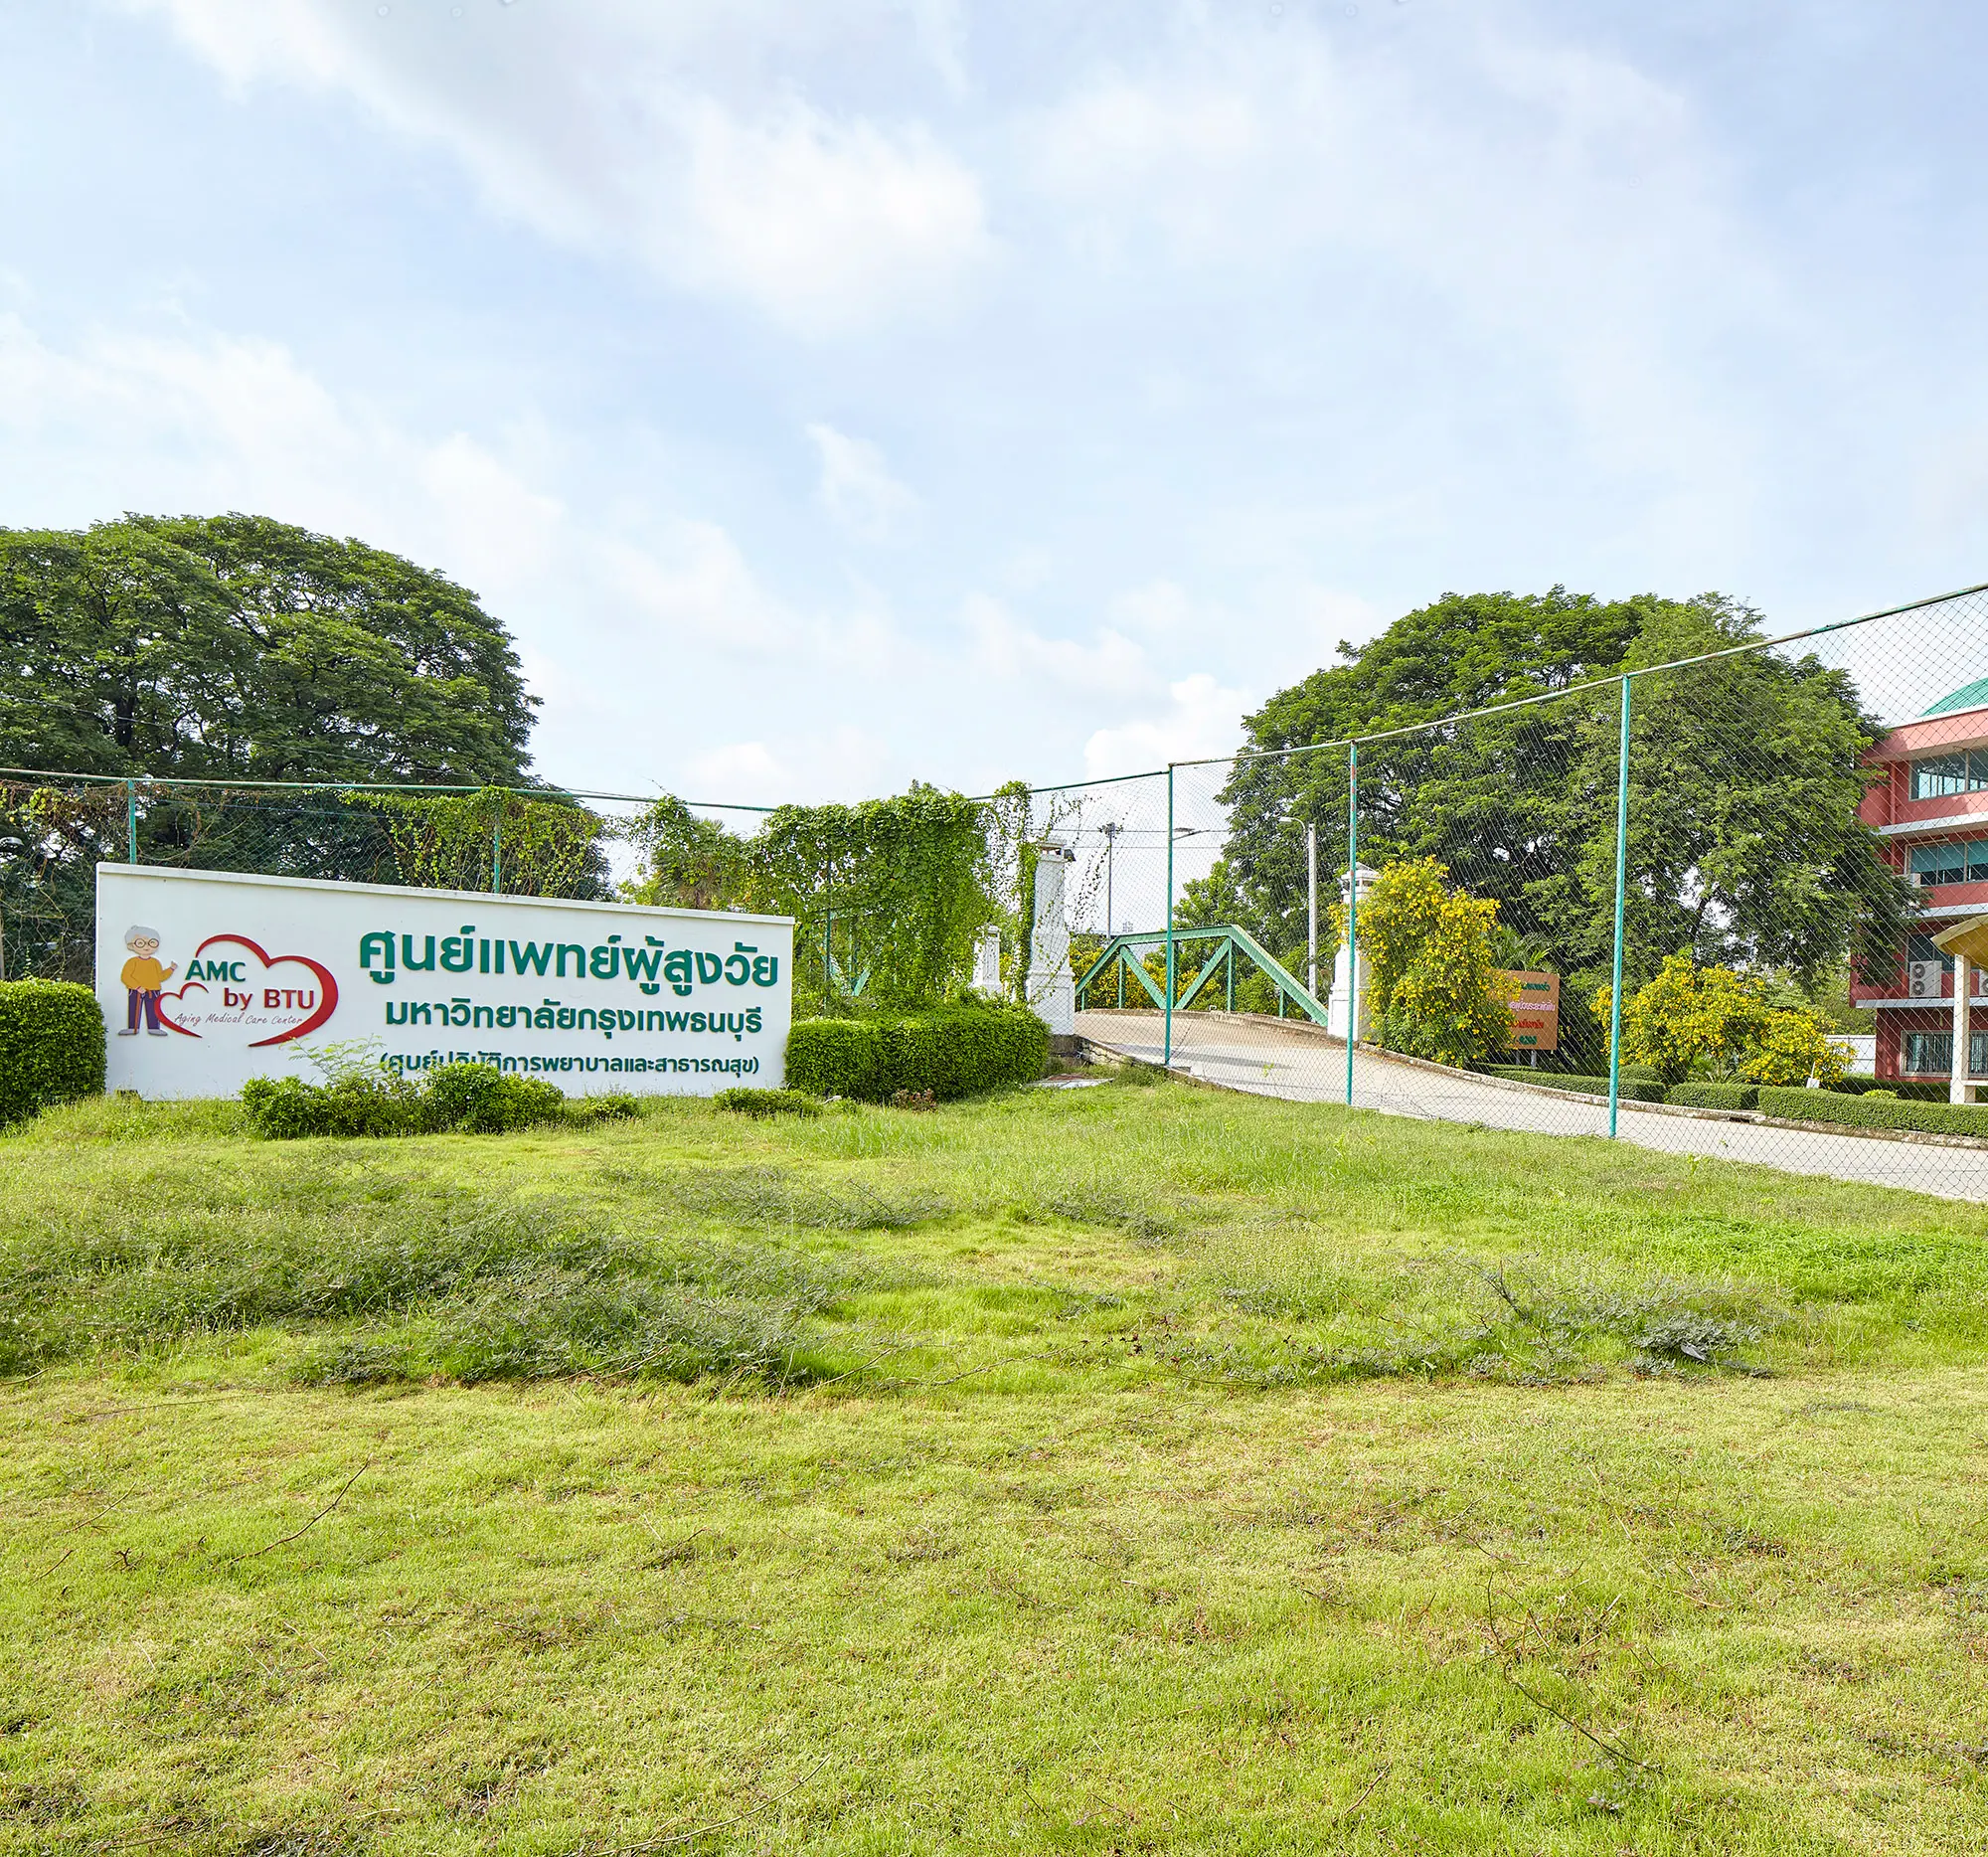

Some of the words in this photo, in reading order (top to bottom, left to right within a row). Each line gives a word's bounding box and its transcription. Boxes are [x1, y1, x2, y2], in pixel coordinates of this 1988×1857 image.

[185, 959, 247, 982] AMC
[359, 926, 778, 996] ศูนย์แพทย์ผู้สูงวัย
[224, 987, 253, 1011] by
[263, 988, 314, 1009] BTU
[174, 1012, 202, 1026] Aging
[205, 1012, 246, 1024] Medical
[245, 1015, 268, 1024] Care
[270, 1015, 303, 1025] Center
[386, 997, 762, 1041] มหาวิทยาลัยกรุงเทพธนบุรี
